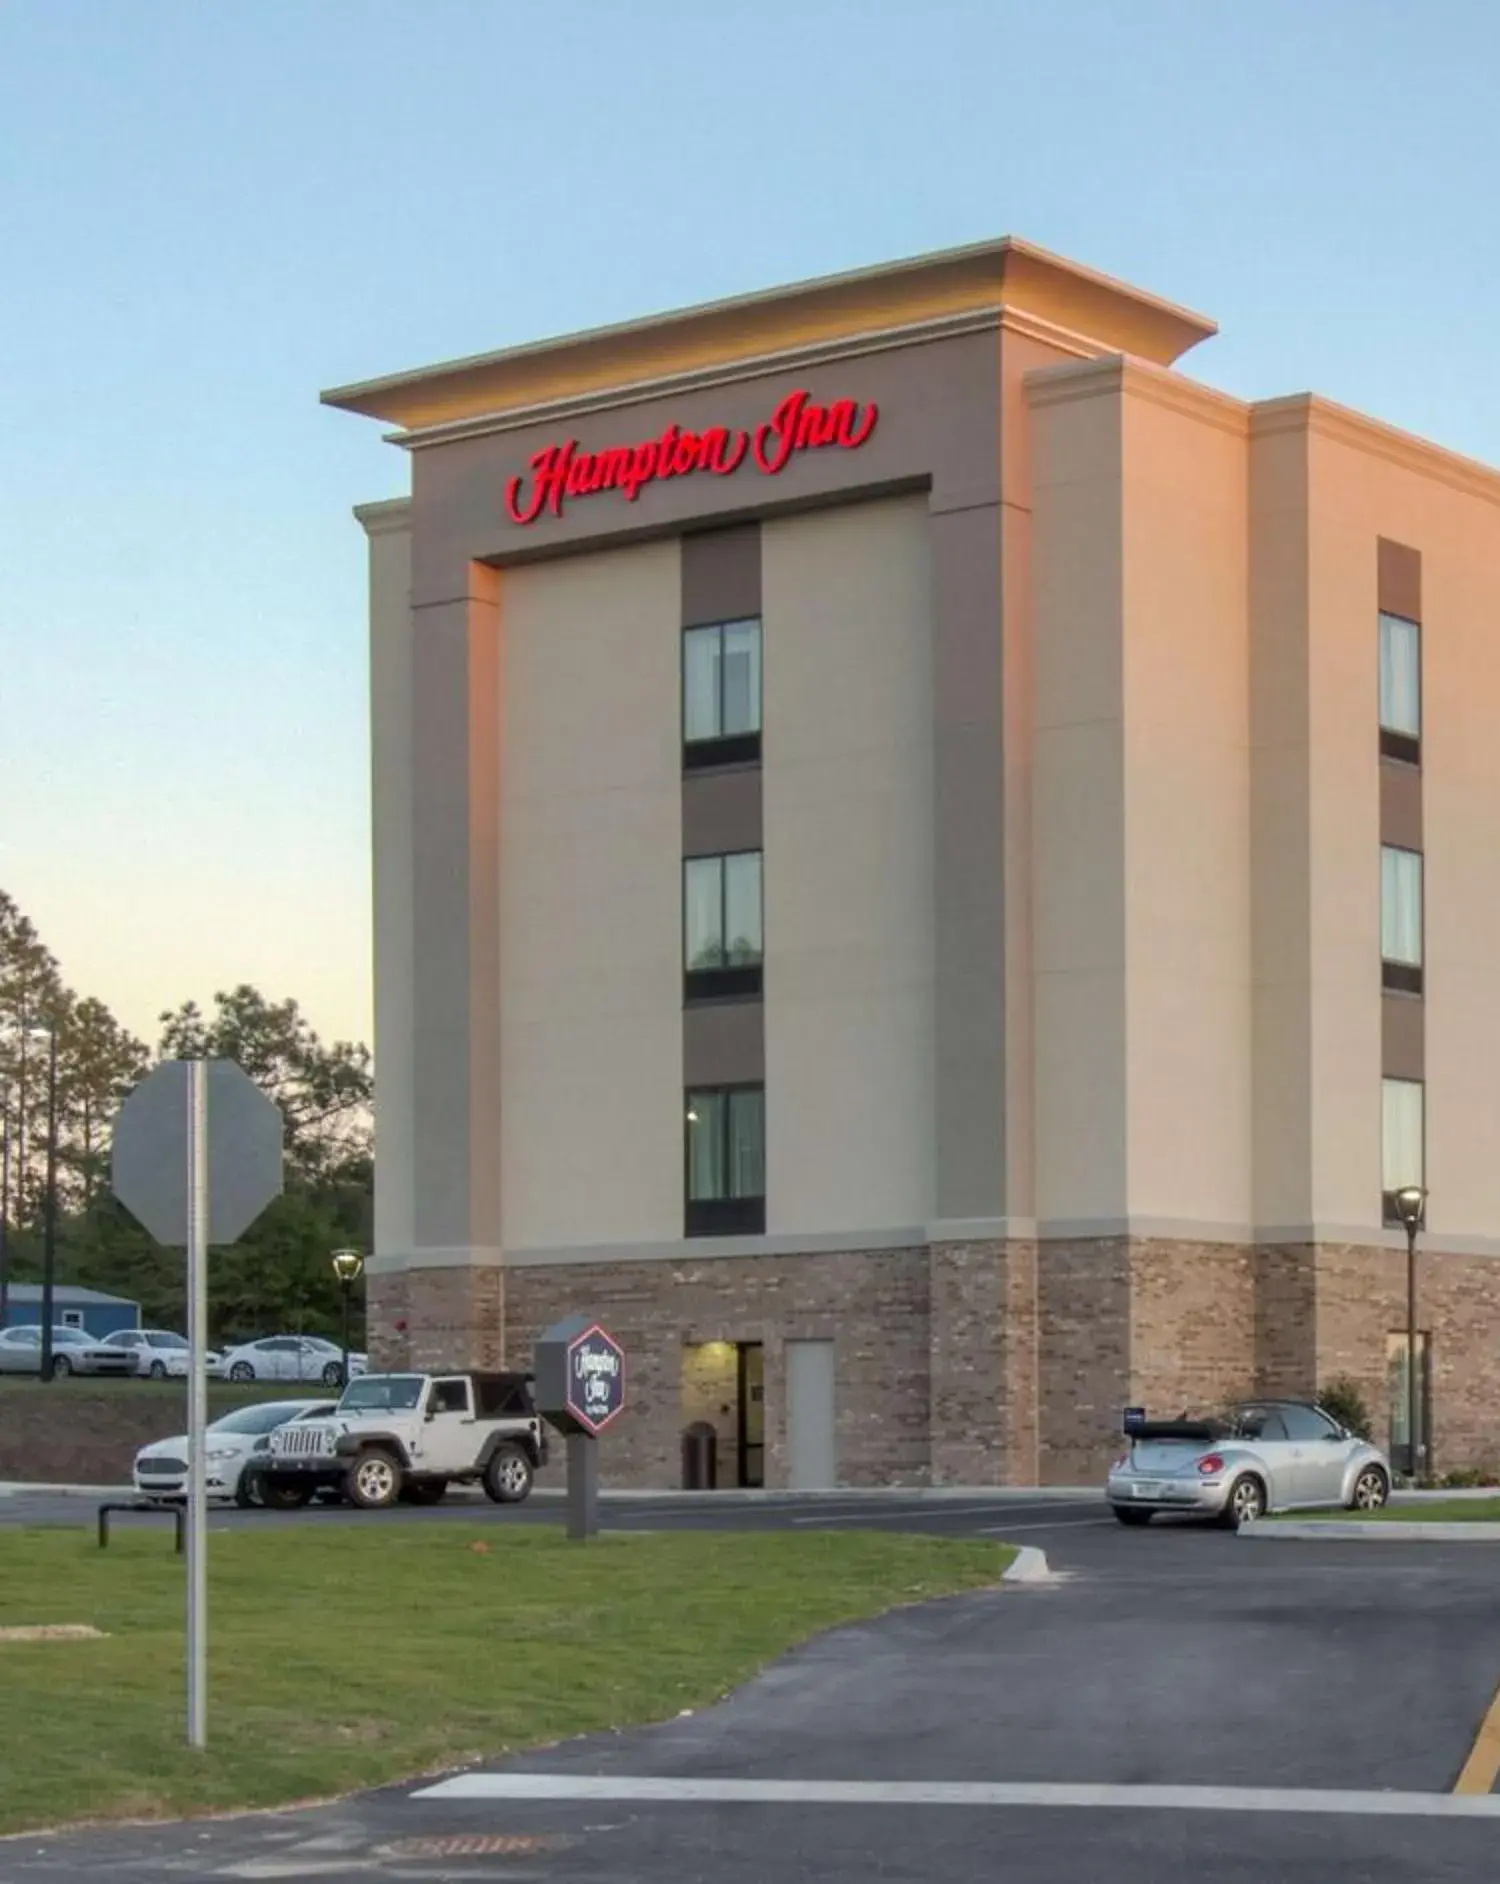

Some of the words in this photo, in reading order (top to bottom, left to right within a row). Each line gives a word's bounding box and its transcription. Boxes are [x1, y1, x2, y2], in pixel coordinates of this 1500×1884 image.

[506, 424, 750, 525] Hampton
[754, 388, 879, 475] Inn
[575, 1344, 619, 1380] Hampton
